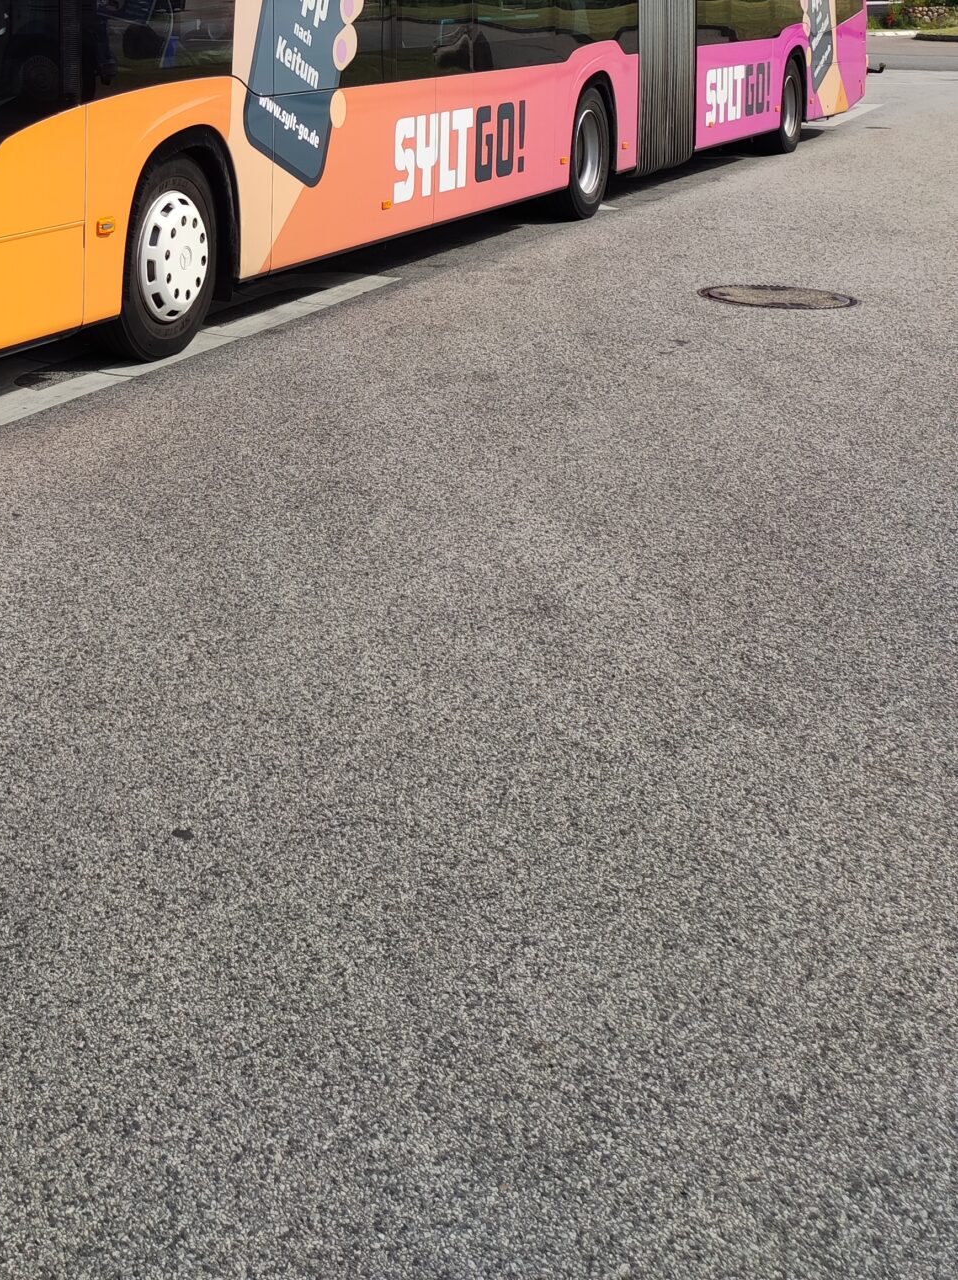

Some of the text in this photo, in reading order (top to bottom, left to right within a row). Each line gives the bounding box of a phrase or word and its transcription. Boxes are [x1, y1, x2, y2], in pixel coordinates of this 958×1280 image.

[293, 22, 313, 47] nach
[275, 35, 320, 90] Keitum
[258, 93, 320, 148] www.sylt-go.de
